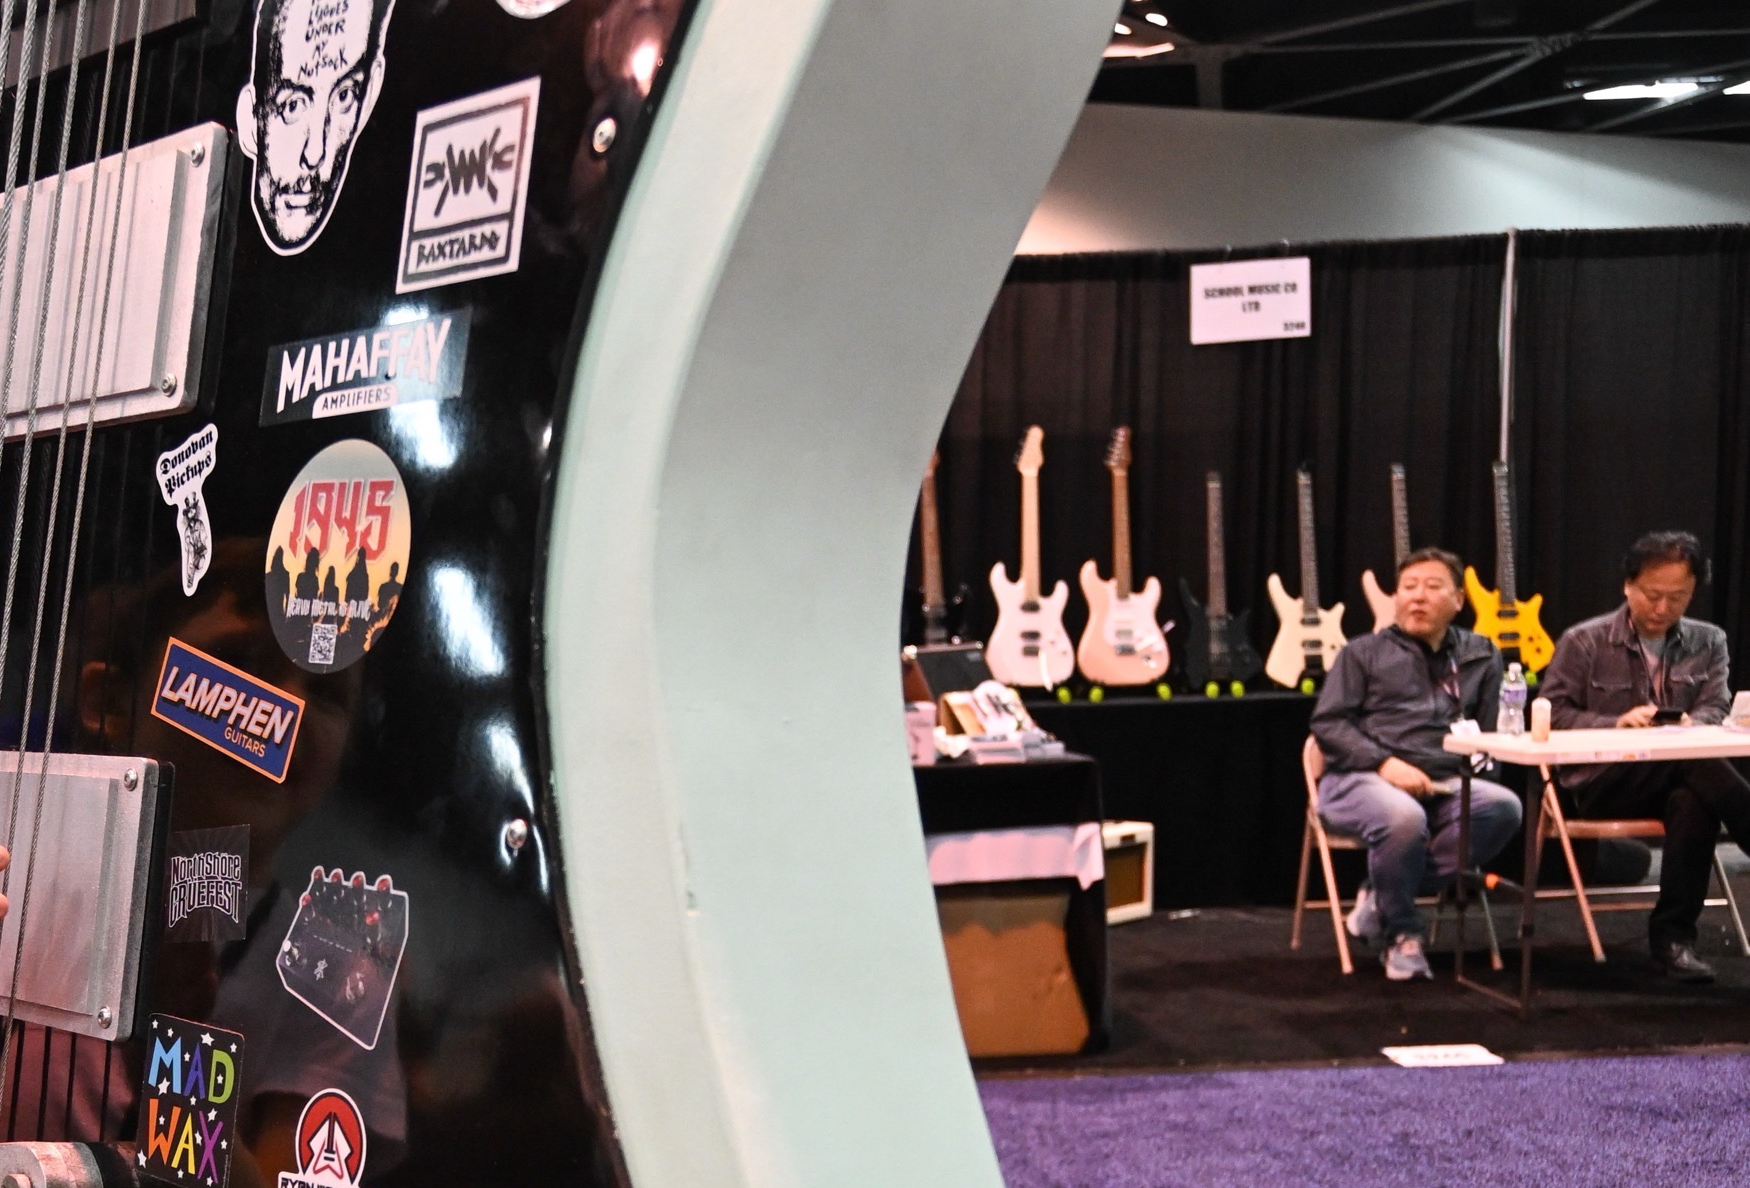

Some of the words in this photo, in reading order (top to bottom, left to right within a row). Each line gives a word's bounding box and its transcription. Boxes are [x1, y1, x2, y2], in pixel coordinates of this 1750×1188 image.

[305, 19, 346, 42] UNDER
[416, 230, 500, 269] BAXTARDO
[1204, 286, 1244, 299] SCHOOL
[1248, 283, 1281, 296] MUSIC
[277, 317, 452, 414] MAHAFFAY
[321, 387, 392, 411] AMPLIFIERS
[160, 430, 213, 475] Donovan
[165, 450, 212, 499] Pickups
[288, 479, 396, 563] 1945
[161, 666, 294, 745] LAMPHEN
[224, 727, 267, 758] GUITARS
[148, 1036, 235, 1104] MAD
[148, 1099, 224, 1184] WAX
